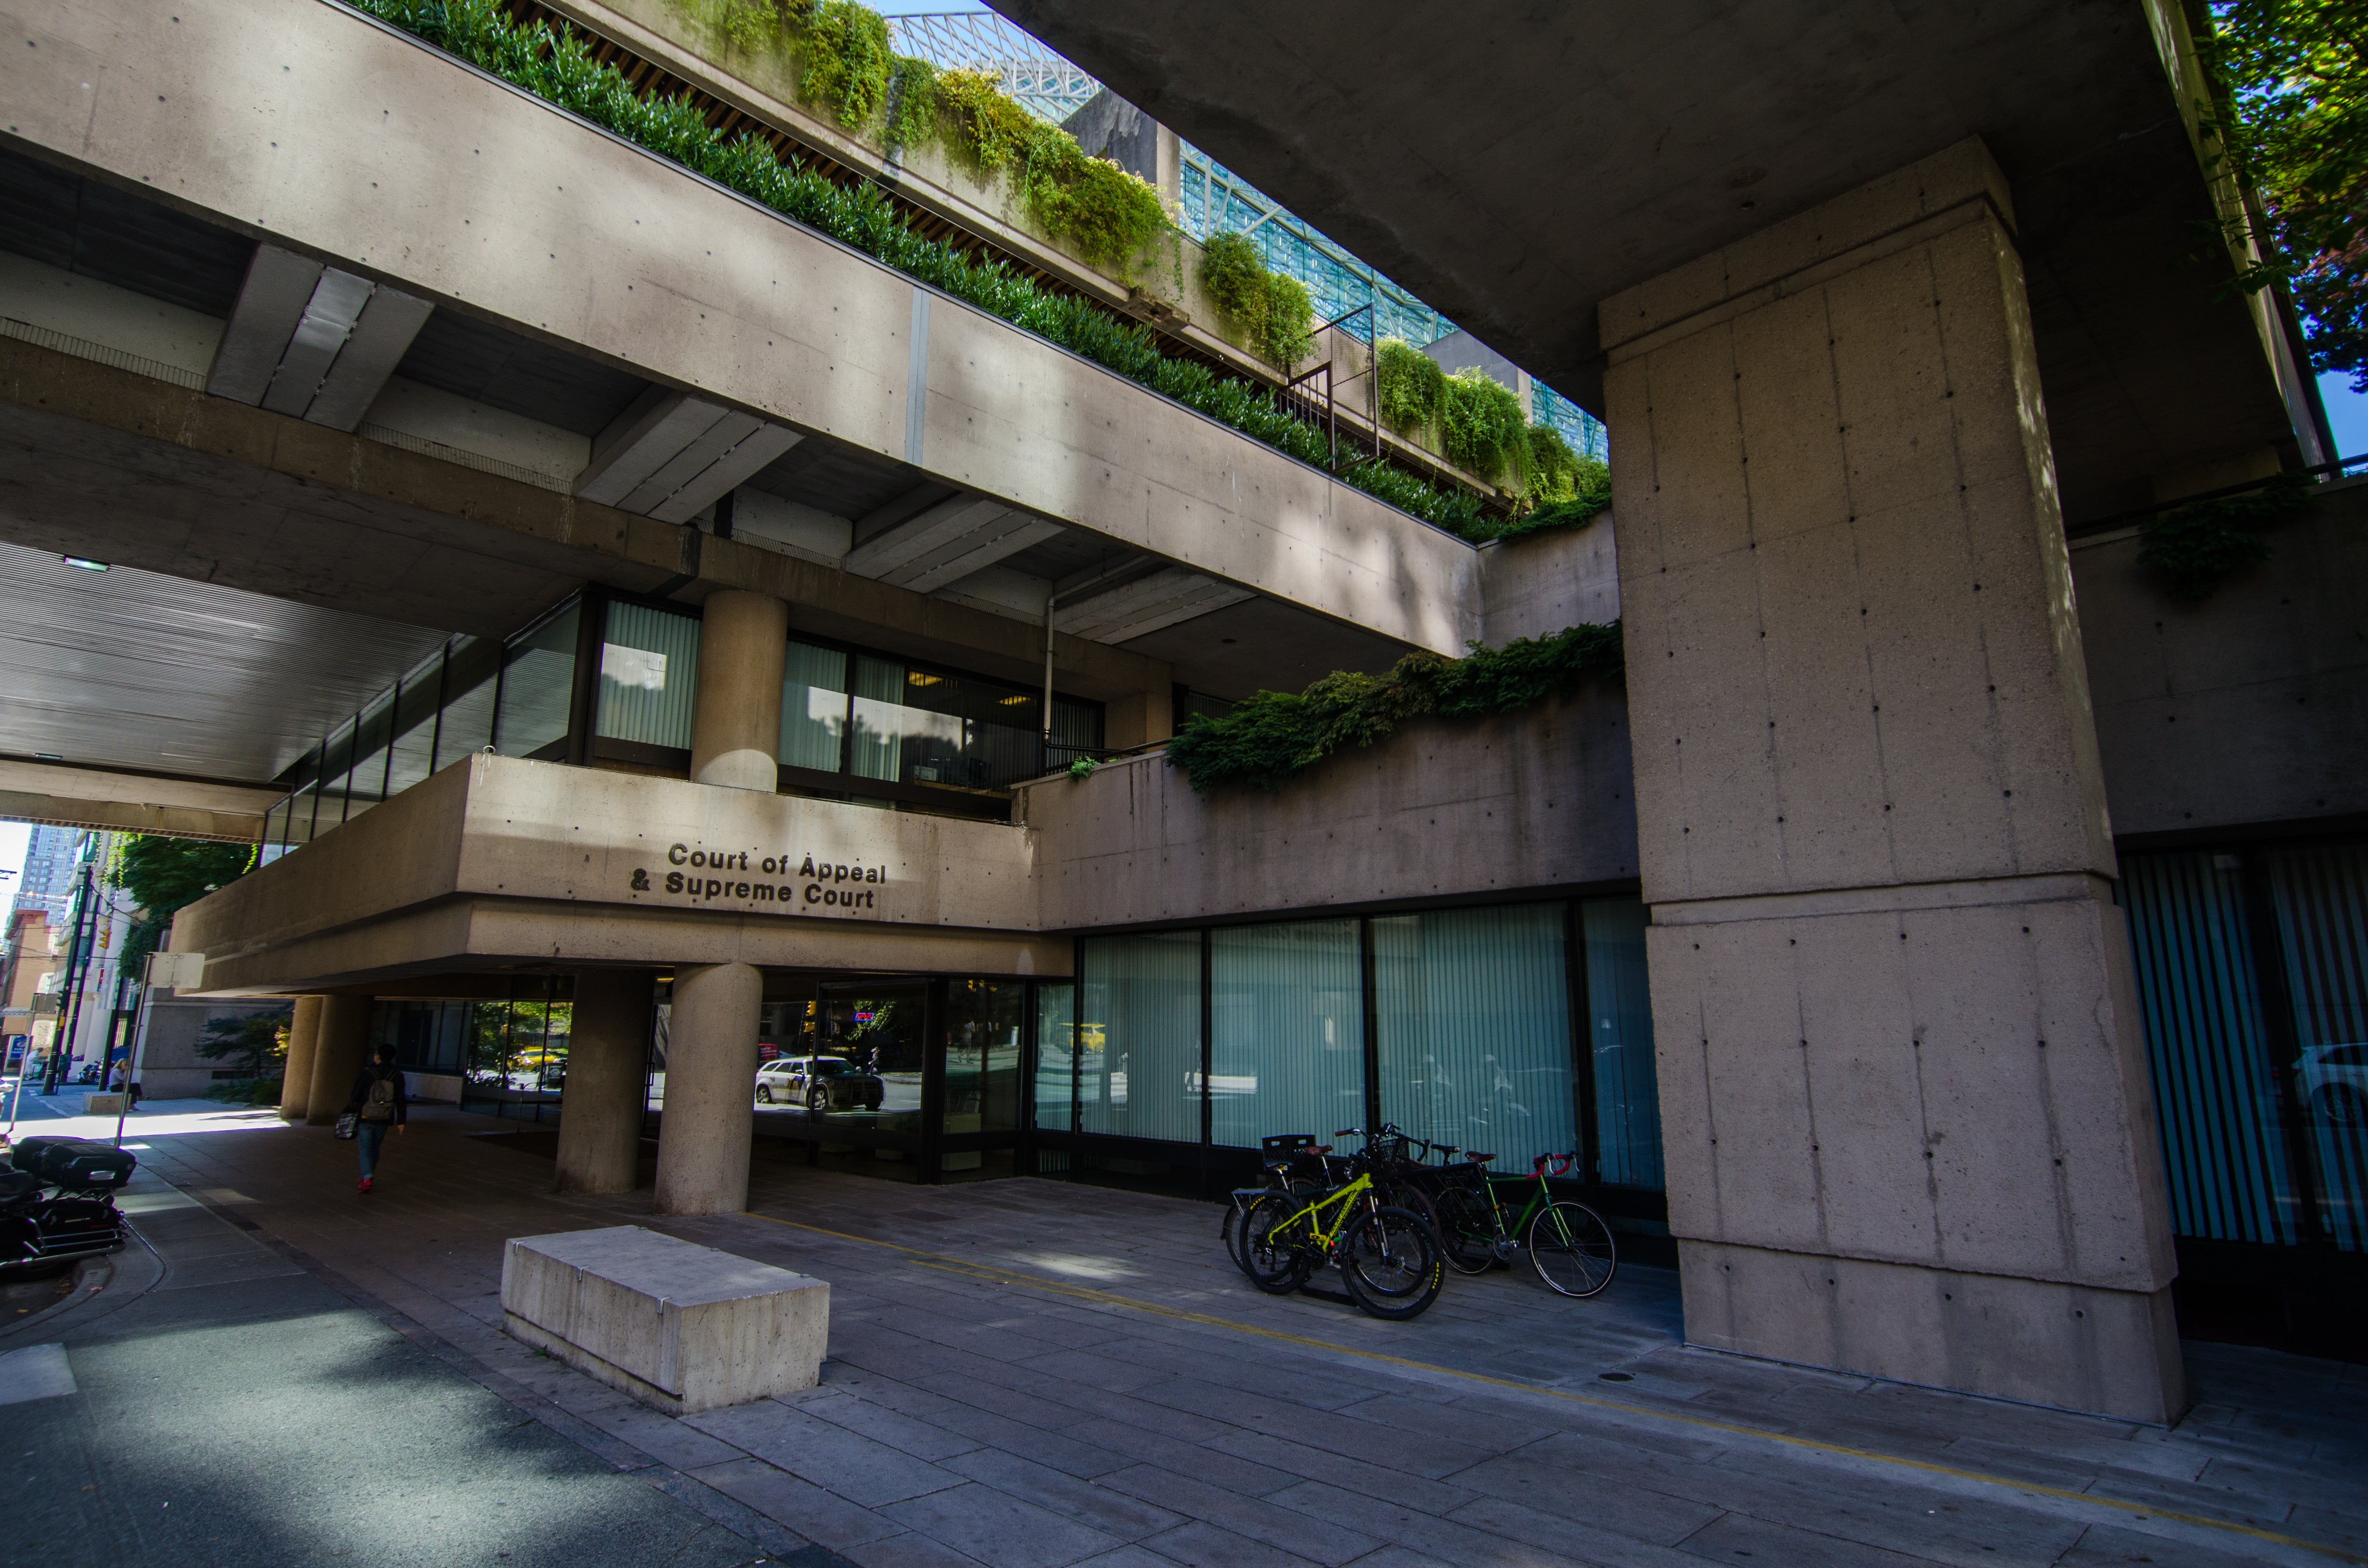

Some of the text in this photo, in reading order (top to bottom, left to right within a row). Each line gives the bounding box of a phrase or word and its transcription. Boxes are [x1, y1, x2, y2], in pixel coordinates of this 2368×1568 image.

[668, 843, 886, 883] Court of Appeal
[630, 868, 874, 908] & Supreme Court
[1250, 1196, 1265, 1210] MAXXIS
[1331, 1215, 1341, 1233] ROCKY
[1341, 1188, 1357, 1216] MOUNTAIN
